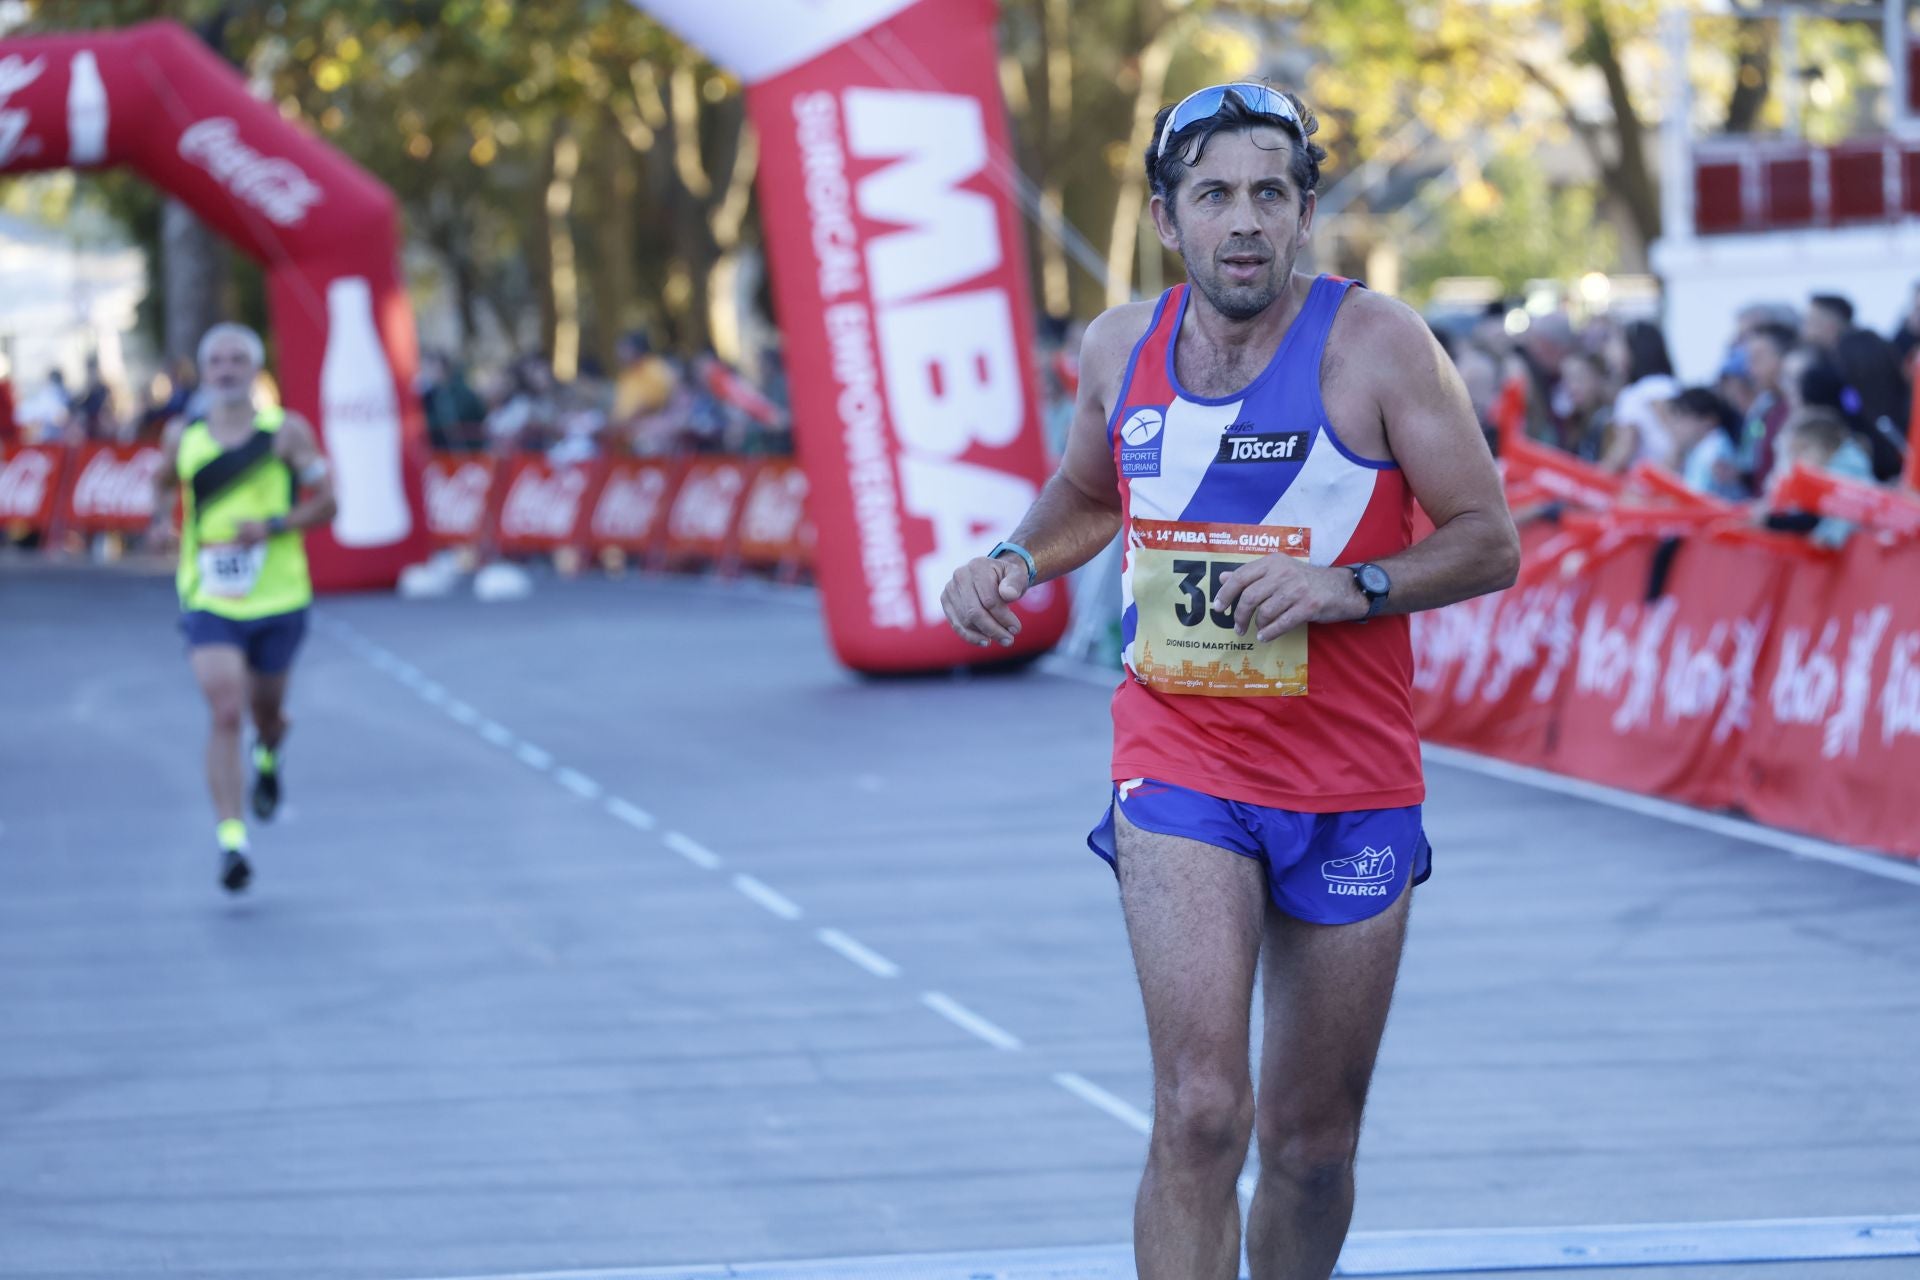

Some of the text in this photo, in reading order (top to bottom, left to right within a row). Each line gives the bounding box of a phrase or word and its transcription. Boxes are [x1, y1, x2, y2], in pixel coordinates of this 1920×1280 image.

[796, 92, 916, 630] SURGICAL EMPOWERMENT
[843, 86, 1040, 624] MBA
[1228, 436, 1298, 460] Toscaf
[1121, 452, 1158, 461] DEPORTE
[1173, 531, 1207, 543] MBA
[1240, 533, 1280, 547] GIJÓN
[1166, 639, 1254, 650] DIONISIO MARTÍNEZ
[1358, 858, 1379, 875] RF
[1328, 883, 1387, 896] LUARCA
